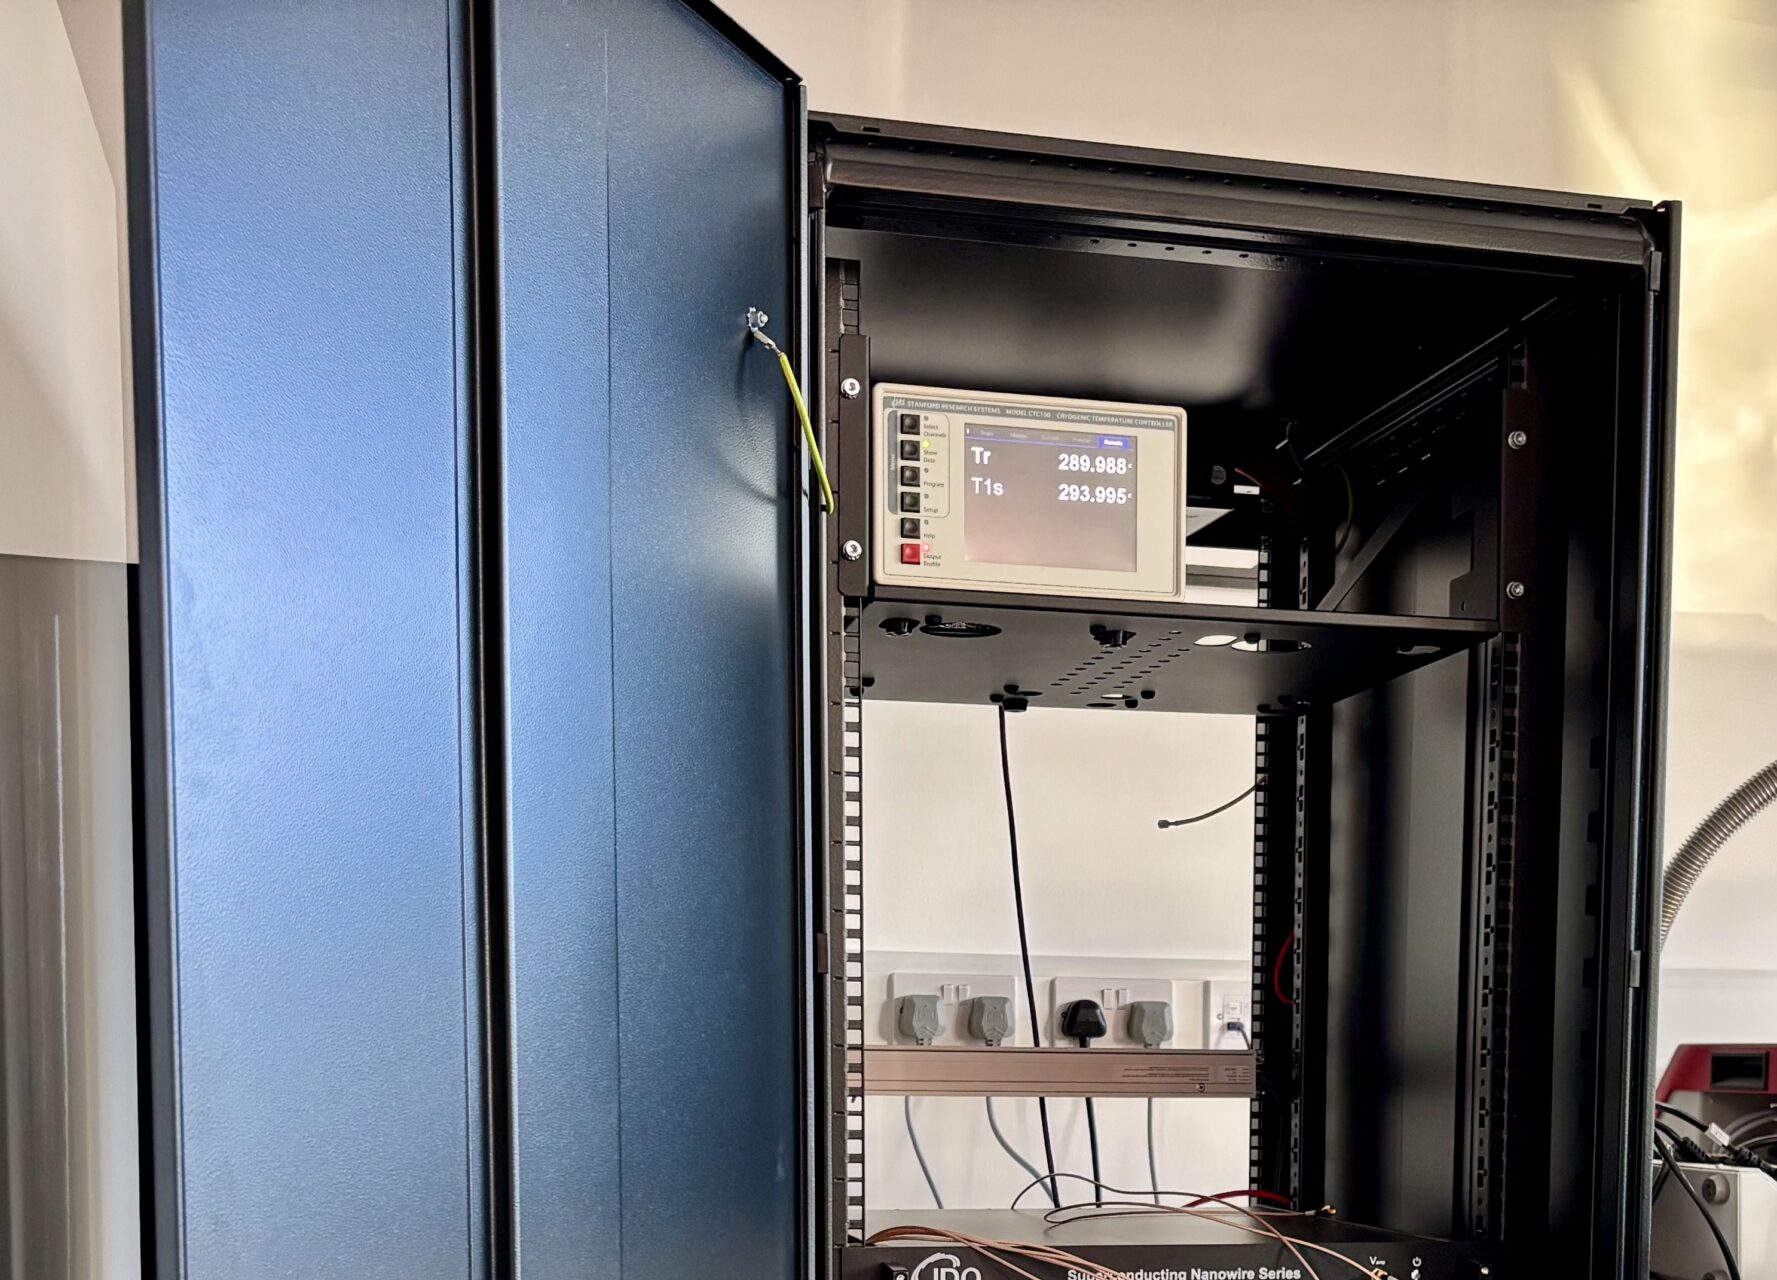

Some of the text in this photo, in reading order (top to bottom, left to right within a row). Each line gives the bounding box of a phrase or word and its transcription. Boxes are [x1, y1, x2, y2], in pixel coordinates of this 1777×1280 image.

[908, 401, 941, 410] STANFORD
[941, 403, 973, 412] RESEARCH
[973, 405, 1001, 414] SYSTEMS
[1006, 408, 1028, 417] MODEL
[1056, 412, 1091, 421] CRYOGENIC
[1091, 415, 1133, 425] TEMPERATURE
[1134, 418, 1173, 428] CONTROLLER
[971, 446, 1127, 474] Tr 289.988
[971, 476, 1127, 505] T1s 293.995
[1190, 1267, 1255, 1280] Nanowire
[1258, 1266, 1302, 1280] Series
